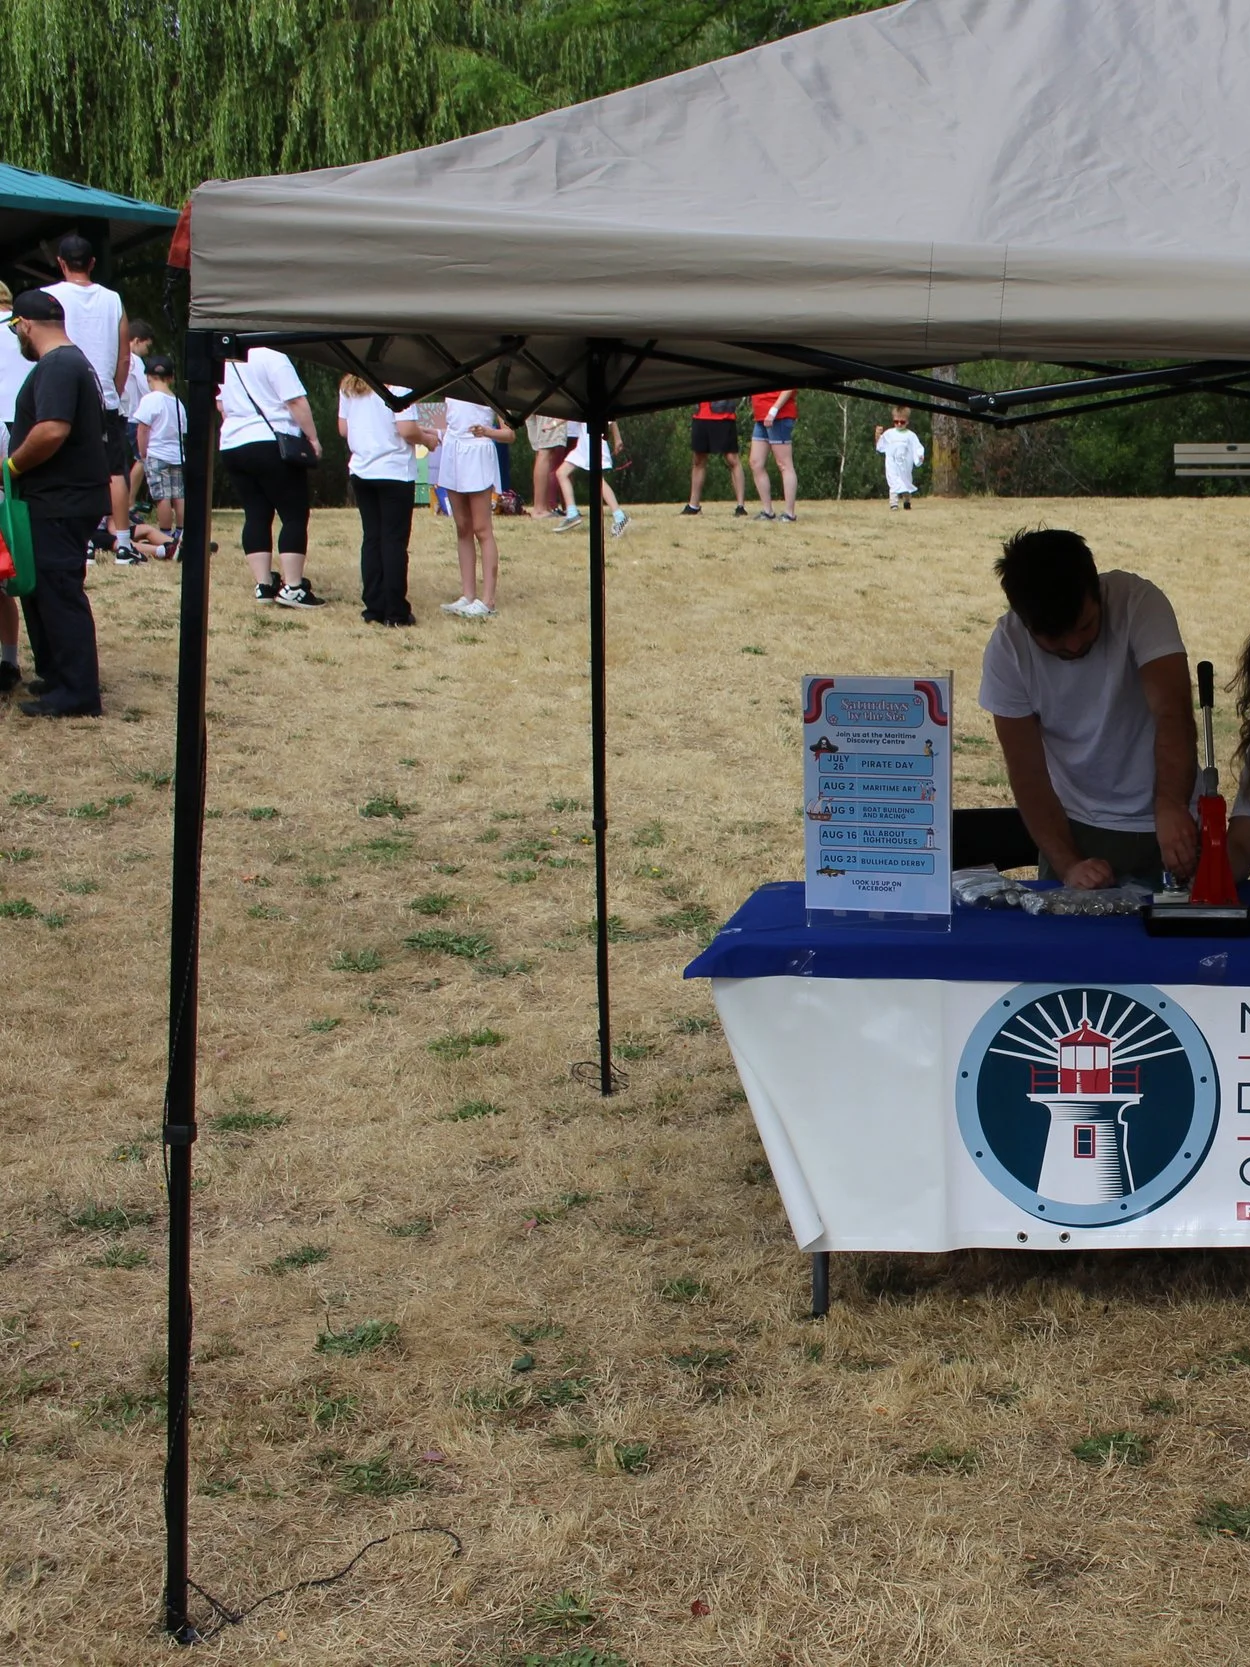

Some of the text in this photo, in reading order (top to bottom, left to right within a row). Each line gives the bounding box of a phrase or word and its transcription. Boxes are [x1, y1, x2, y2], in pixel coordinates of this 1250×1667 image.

[840, 699, 909, 711] Saturdays
[847, 711, 906, 721] by the Sea
[846, 737, 879, 745] Discovery
[827, 754, 850, 763] JULY
[862, 761, 892, 769] PIRATE
[823, 782, 855, 791] AUG 2
[862, 784, 900, 792] MARITIME
[823, 806, 855, 815] AUG 9
[822, 831, 857, 840] AUG 16
[863, 837, 918, 845] LIGHTHOUSES
[823, 855, 857, 863] AUG 23
[861, 858, 899, 866] BULLHEAD
